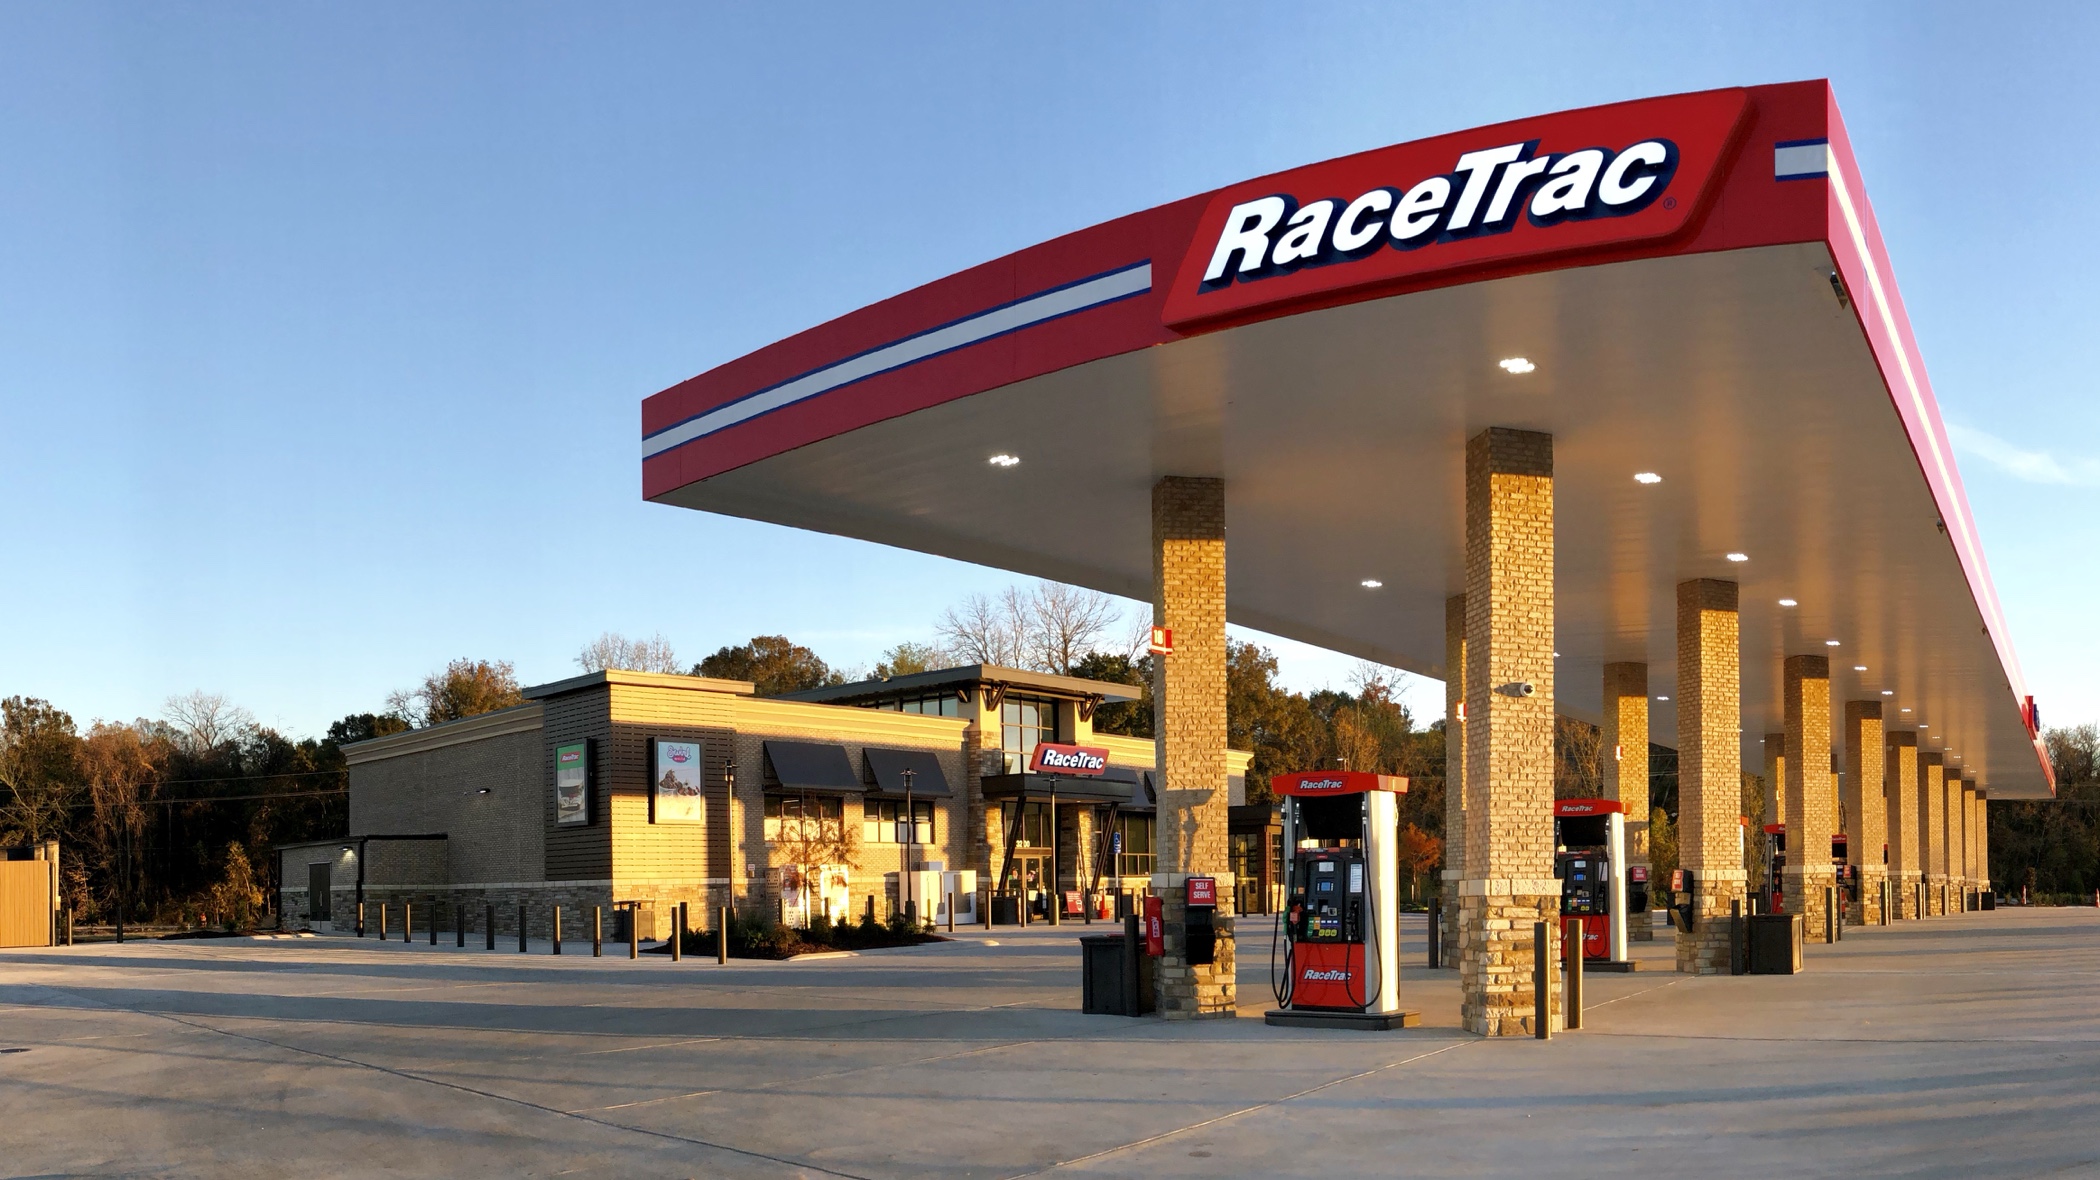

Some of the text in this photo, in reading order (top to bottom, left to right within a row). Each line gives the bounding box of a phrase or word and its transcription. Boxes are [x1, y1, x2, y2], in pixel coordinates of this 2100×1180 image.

[1201, 139, 1669, 285] RaceTrac
[1043, 749, 1105, 769] RaceTrac
[1300, 779, 1343, 789] RaceTrac
[1193, 891, 1211, 899] SERVE
